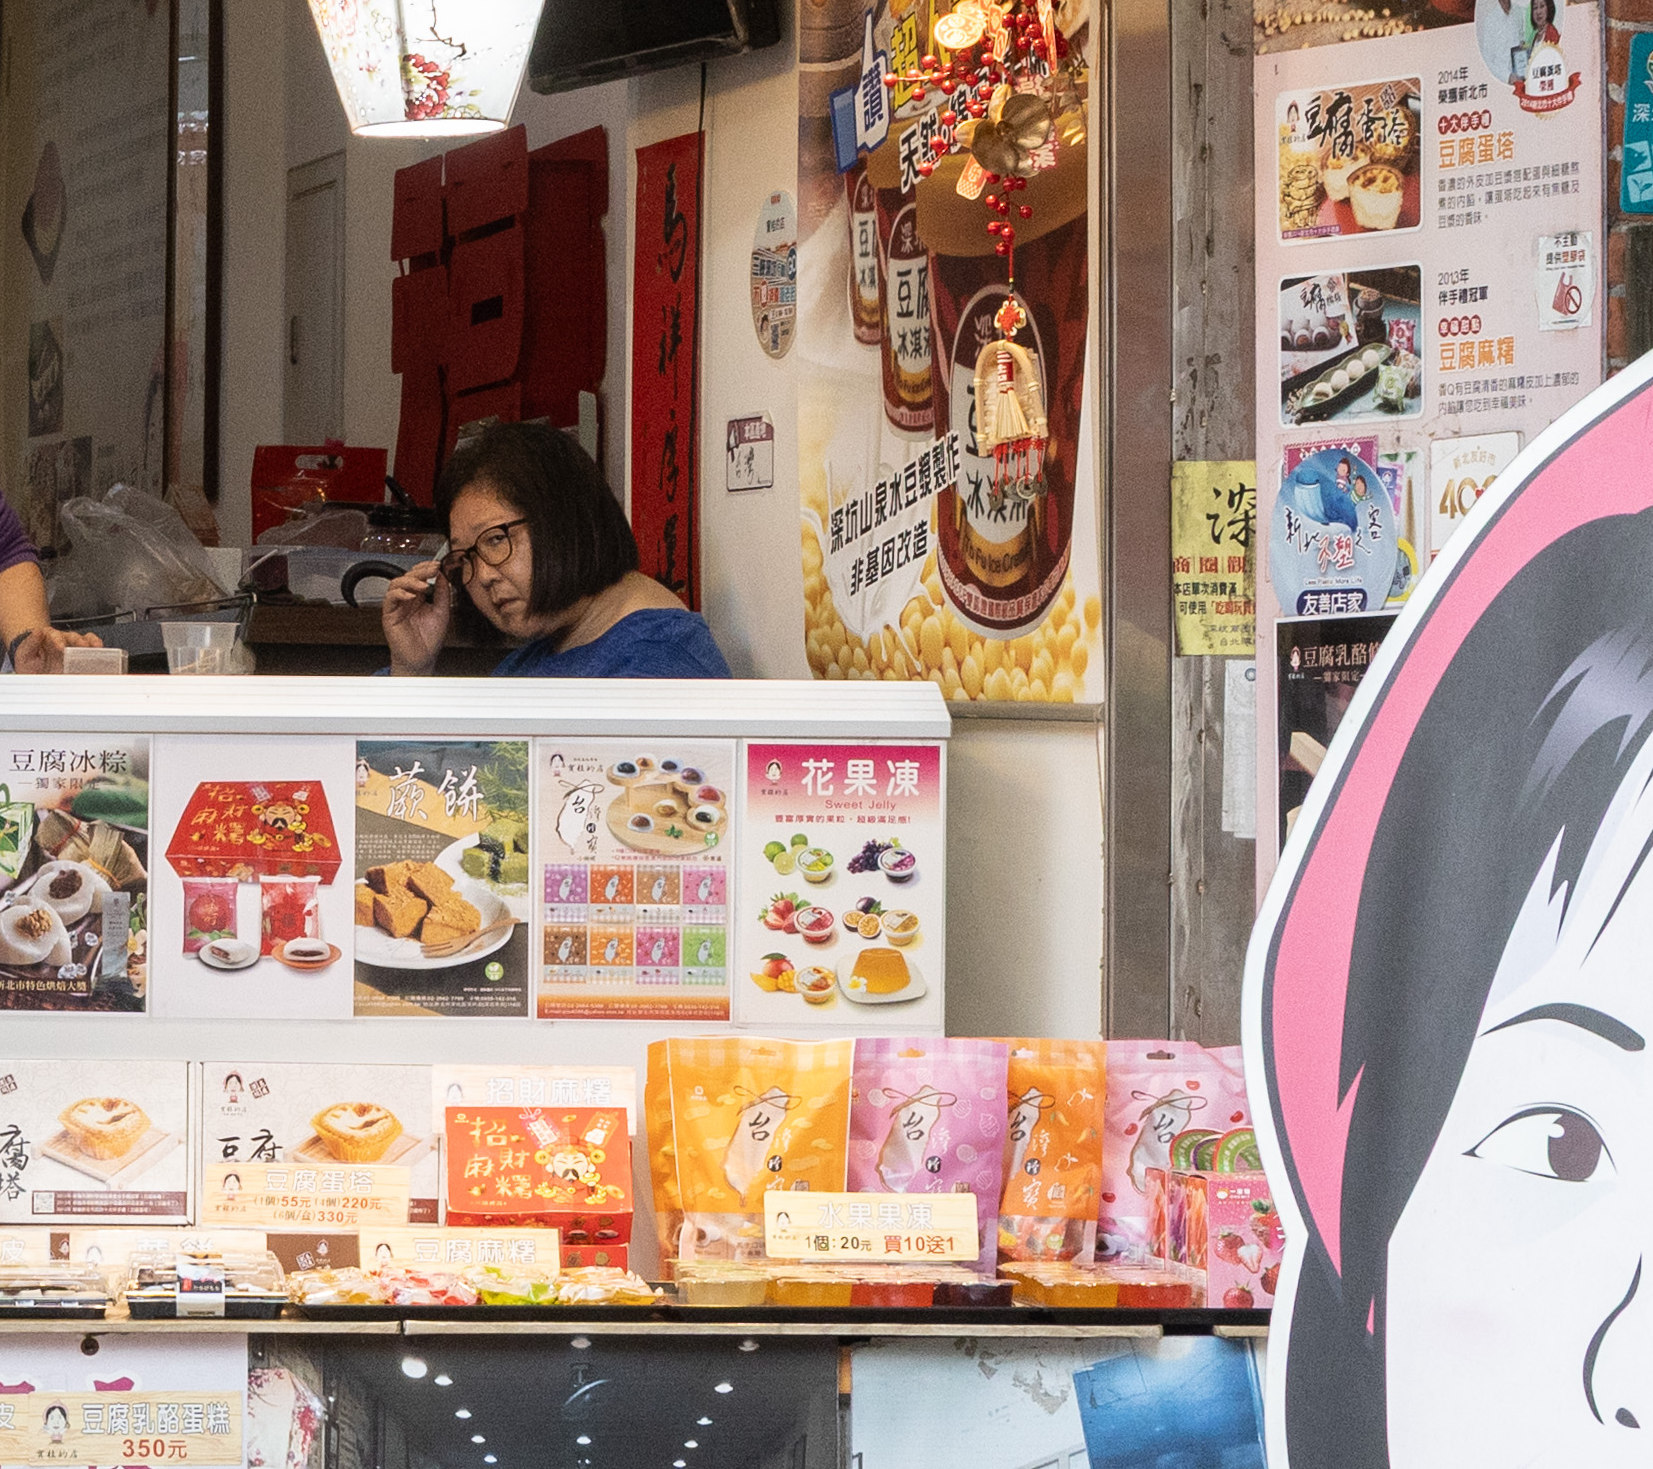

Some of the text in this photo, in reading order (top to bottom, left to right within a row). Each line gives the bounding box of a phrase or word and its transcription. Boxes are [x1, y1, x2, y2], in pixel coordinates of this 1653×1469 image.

[1438, 67, 1469, 86] 2014年
[1438, 132, 1515, 169] 豆腐蛋塔
[1438, 268, 1470, 286] 2013年
[1438, 337, 1515, 373] 豆腐麻糬
[830, 431, 961, 555] 深坑山泉水豆漿製作
[851, 521, 929, 597] 非基因改造
[1302, 592, 1364, 615] 友善店家
[9, 748, 127, 774] 豆腐冰粽
[801, 758, 921, 798] 花果凍
[825, 799, 898, 813] Sweet Jelly
[487, 1077, 613, 1107] 招財麻糬
[264, 1168, 377, 1196] 豆腐蛋塔
[818, 1200, 935, 1231] 水果果凍
[413, 1237, 536, 1265] 豆腐麻糬
[883, 1233, 956, 1255] 買10送1
[82, 1402, 232, 1436] 豆腐乳酪蛋糕
[122, 1438, 189, 1460] 350元
